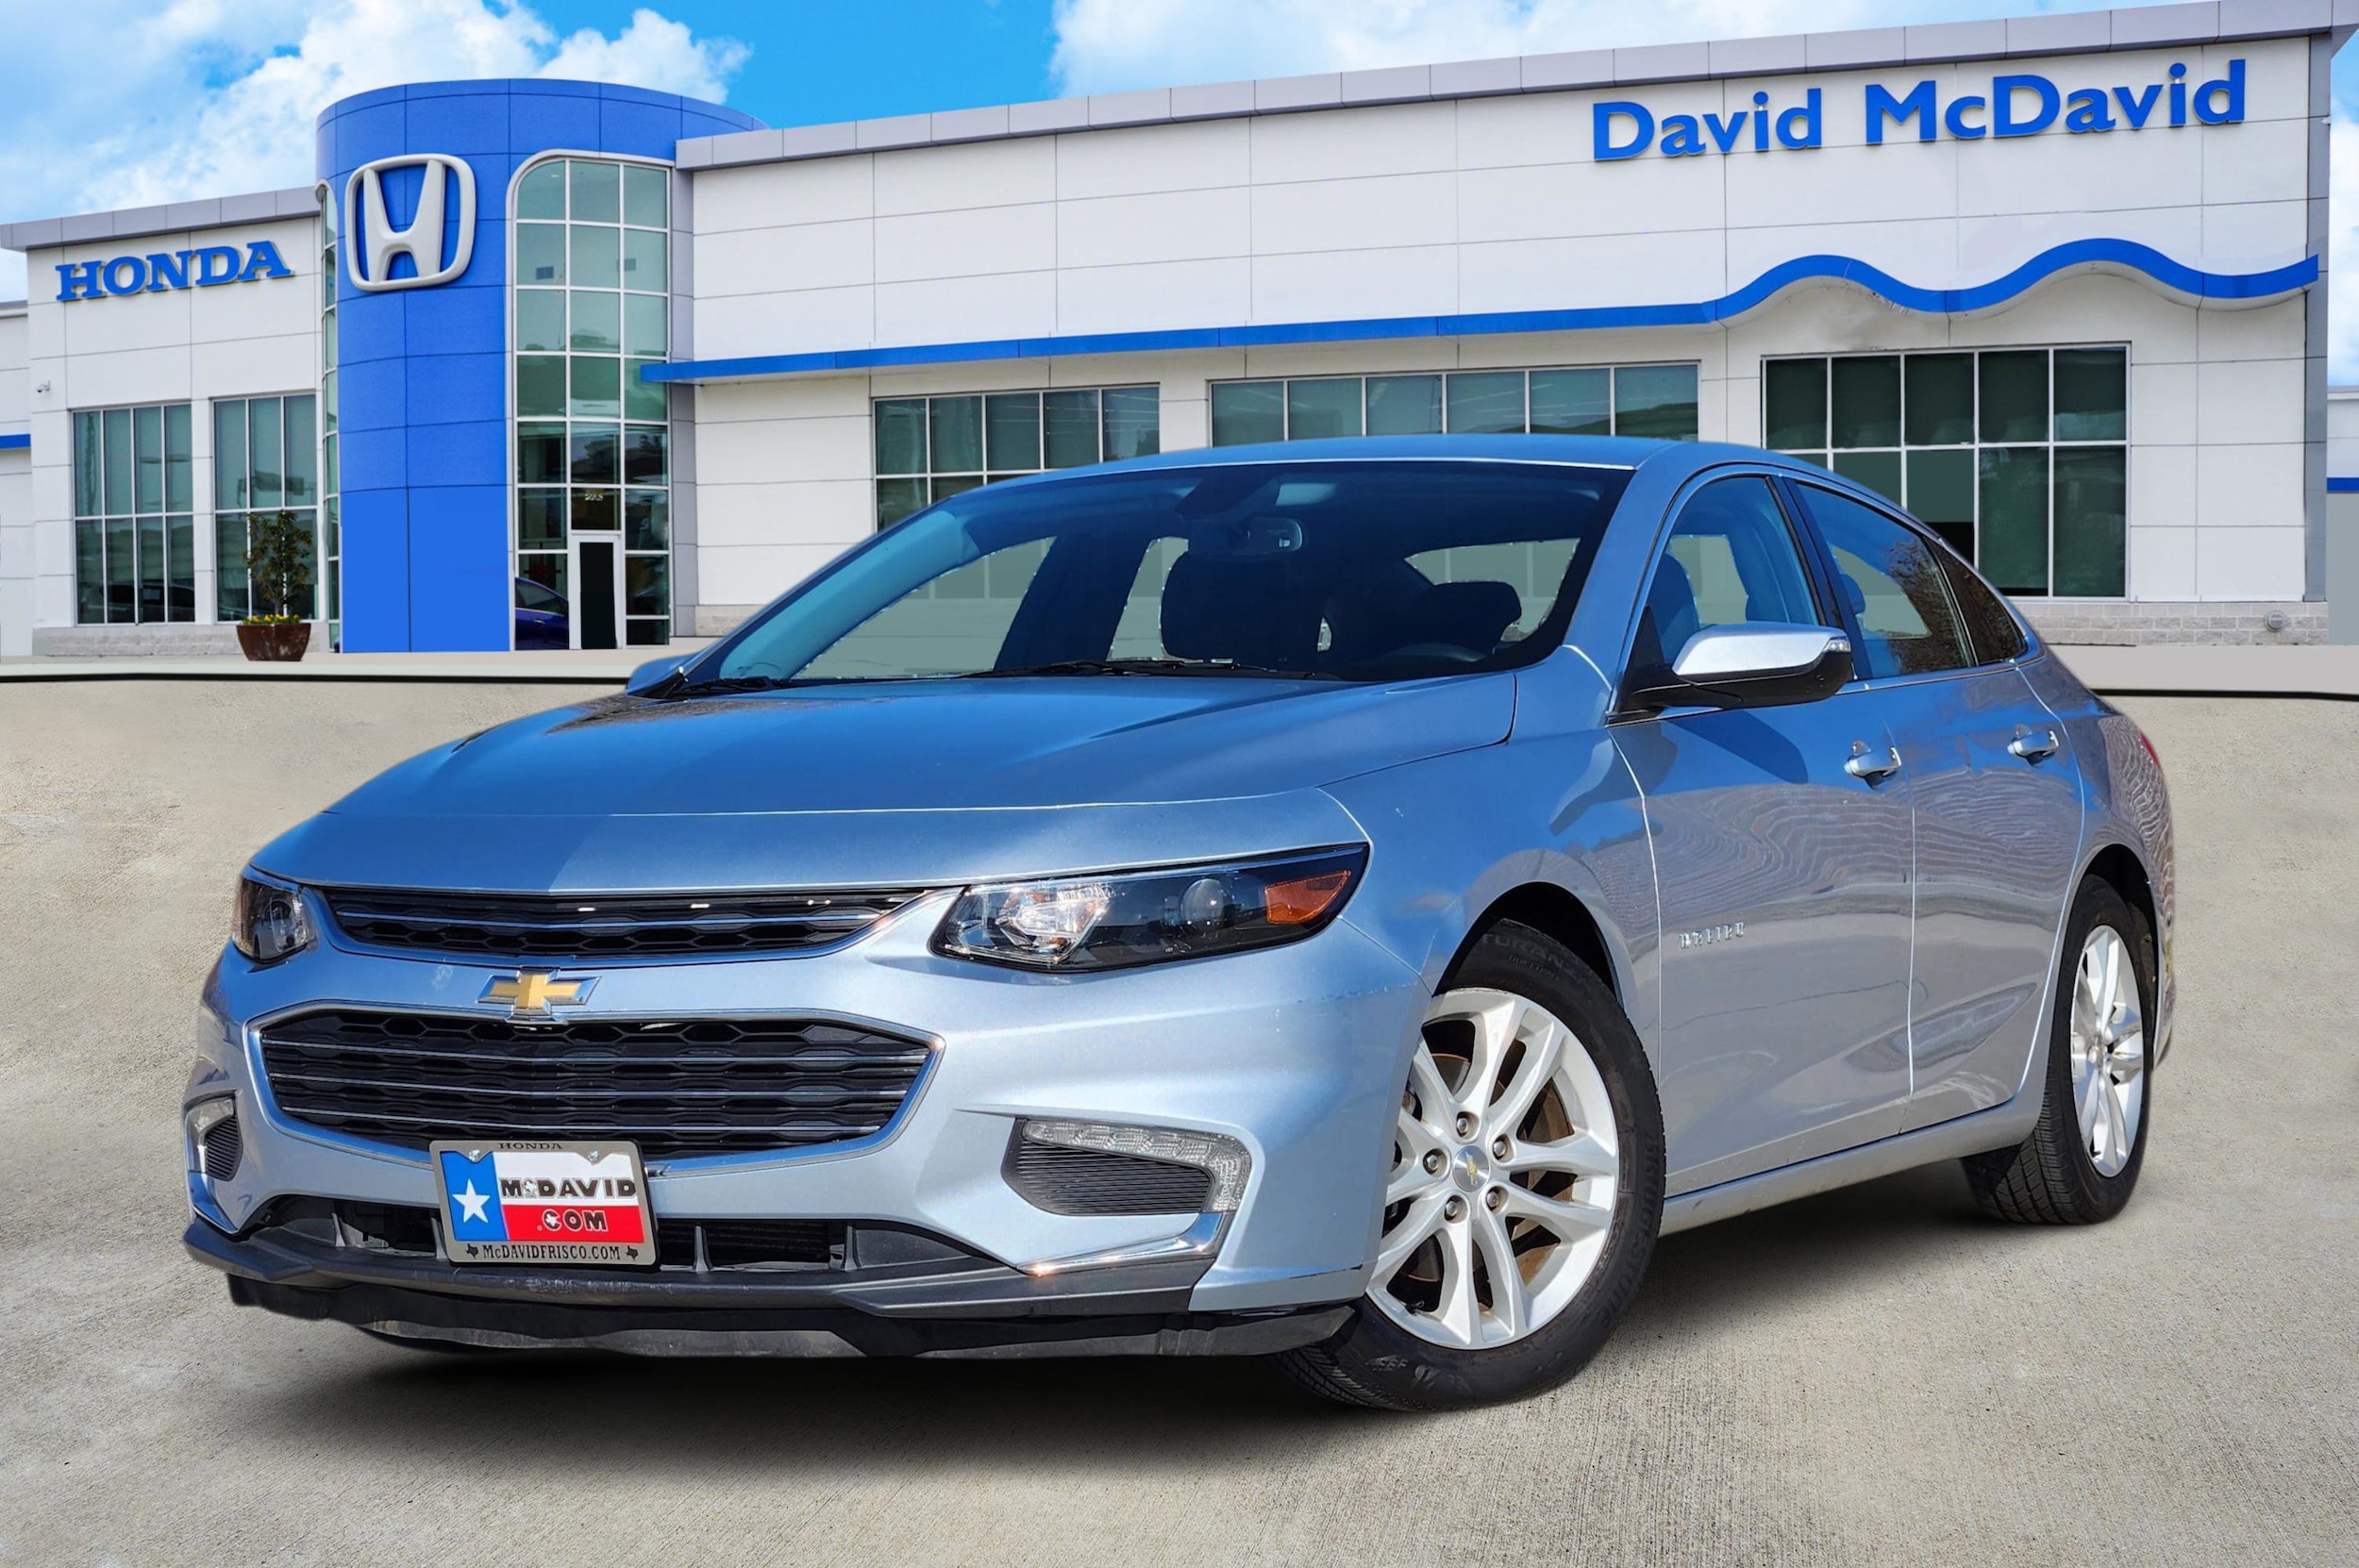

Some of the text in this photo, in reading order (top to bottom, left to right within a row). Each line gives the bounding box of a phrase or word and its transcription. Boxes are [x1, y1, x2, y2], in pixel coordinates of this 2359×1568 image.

[1592, 58, 2246, 161] David McDavid
[56, 240, 293, 302] HONDA
[499, 1142, 563, 1150] HONDA
